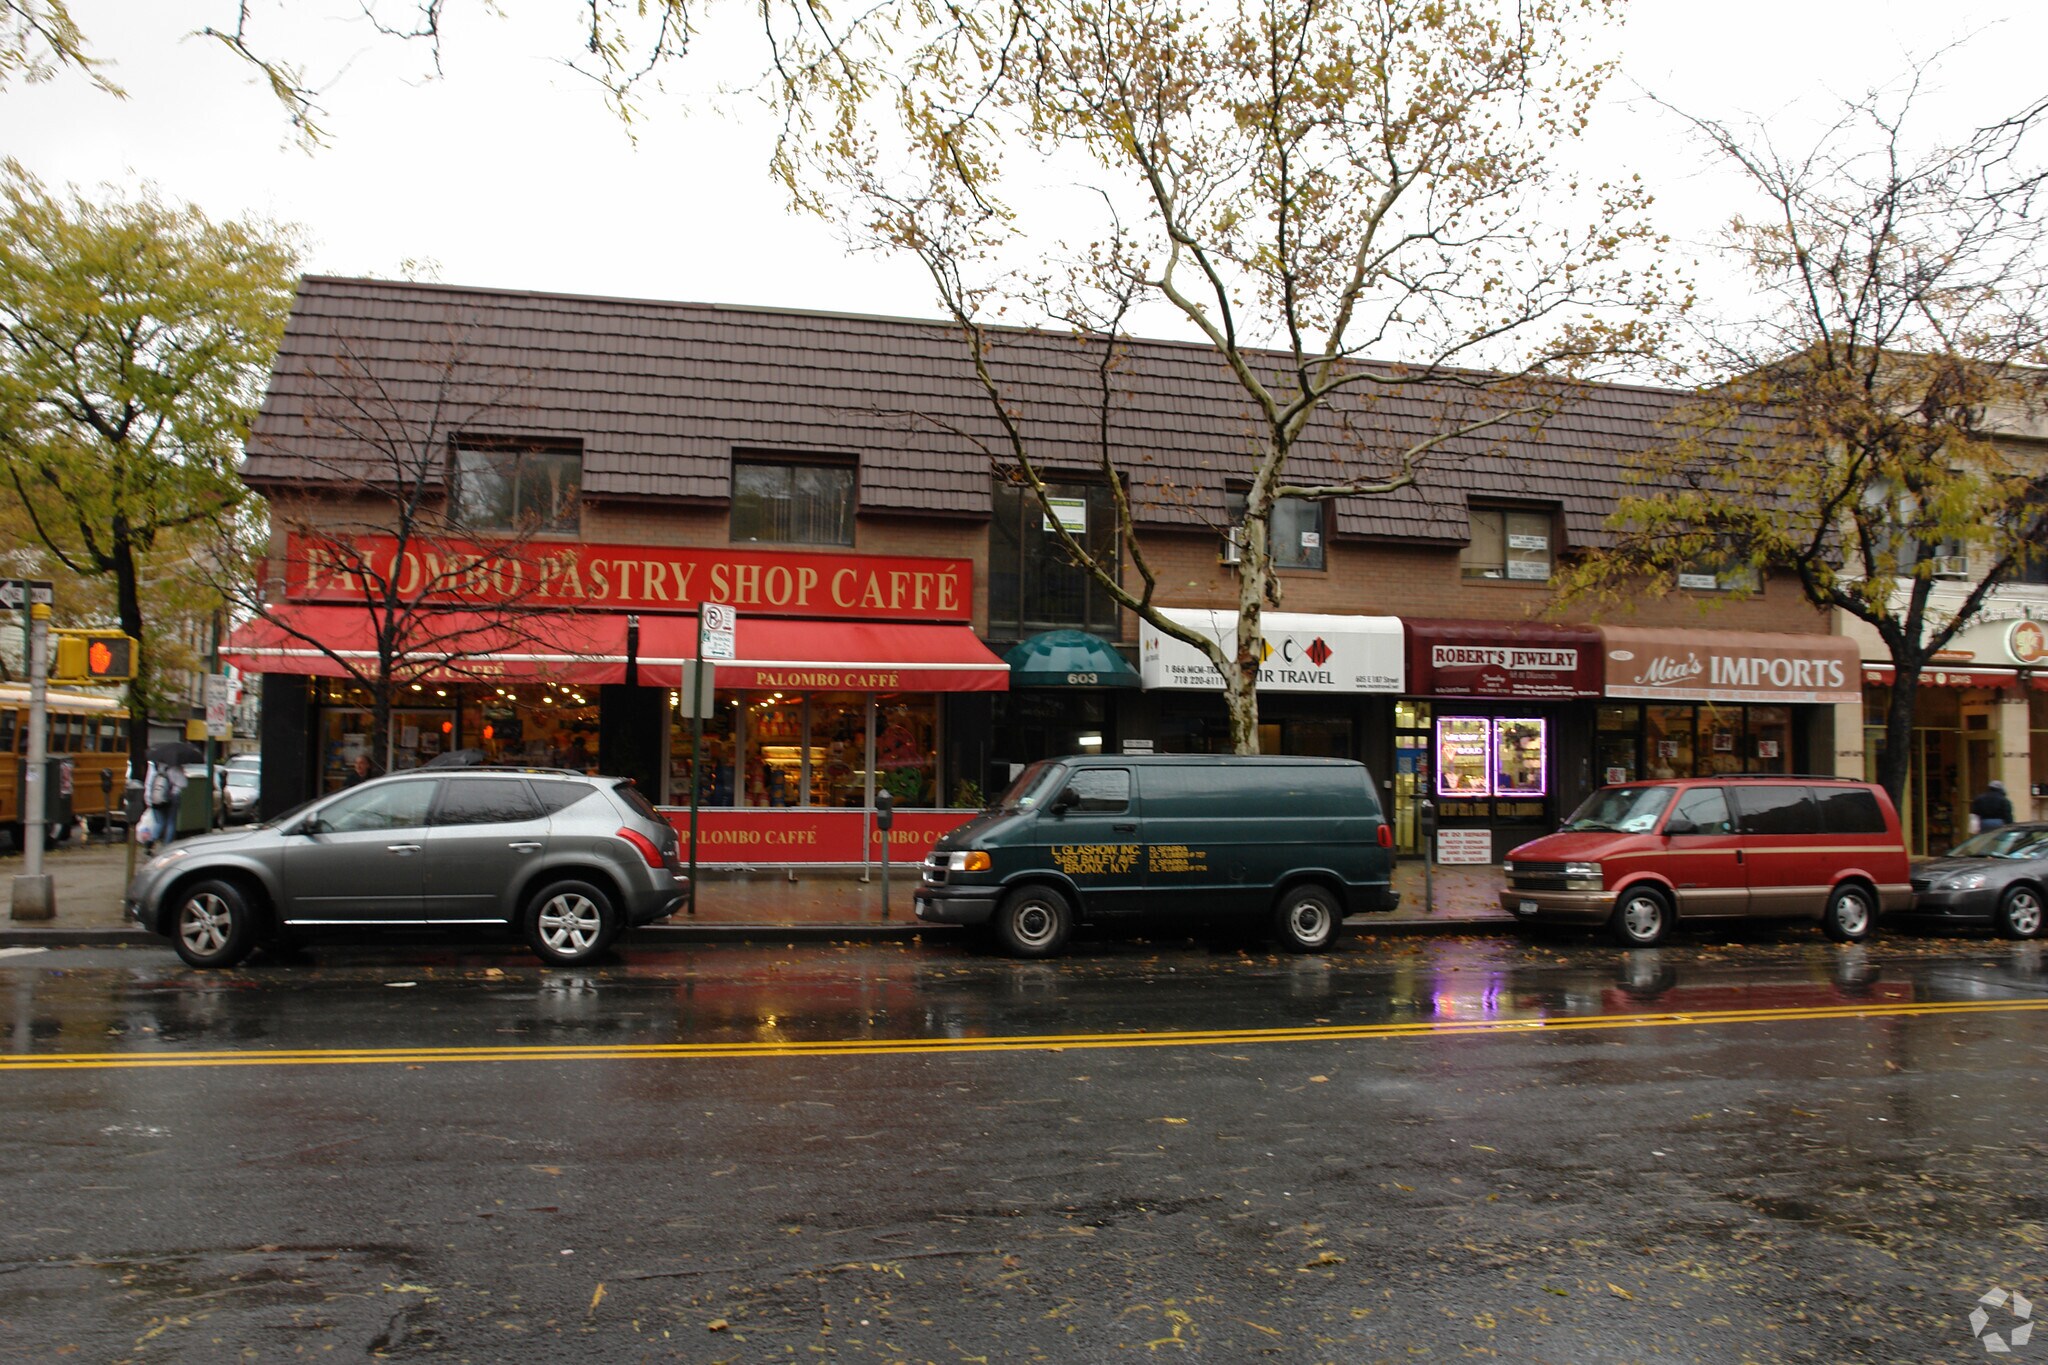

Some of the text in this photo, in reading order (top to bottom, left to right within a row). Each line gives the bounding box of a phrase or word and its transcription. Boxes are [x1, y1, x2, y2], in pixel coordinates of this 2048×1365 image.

[304, 548, 959, 611] PALOMBO PASTRY SHOP CAFFÉ
[1435, 648, 1577, 668] ROBERT'S JEWELRY
[1278, 669, 1336, 685] TRAVEL
[1633, 652, 1845, 687] Mia's IMPORTS
[756, 671, 900, 687] PALOMBO CAFFÉ
[1067, 672, 1099, 685] 603
[1174, 676, 1189, 685] 718
[681, 825, 817, 845] PLOMBO CAFFÉ
[1081, 854, 1117, 865] BAILEY
